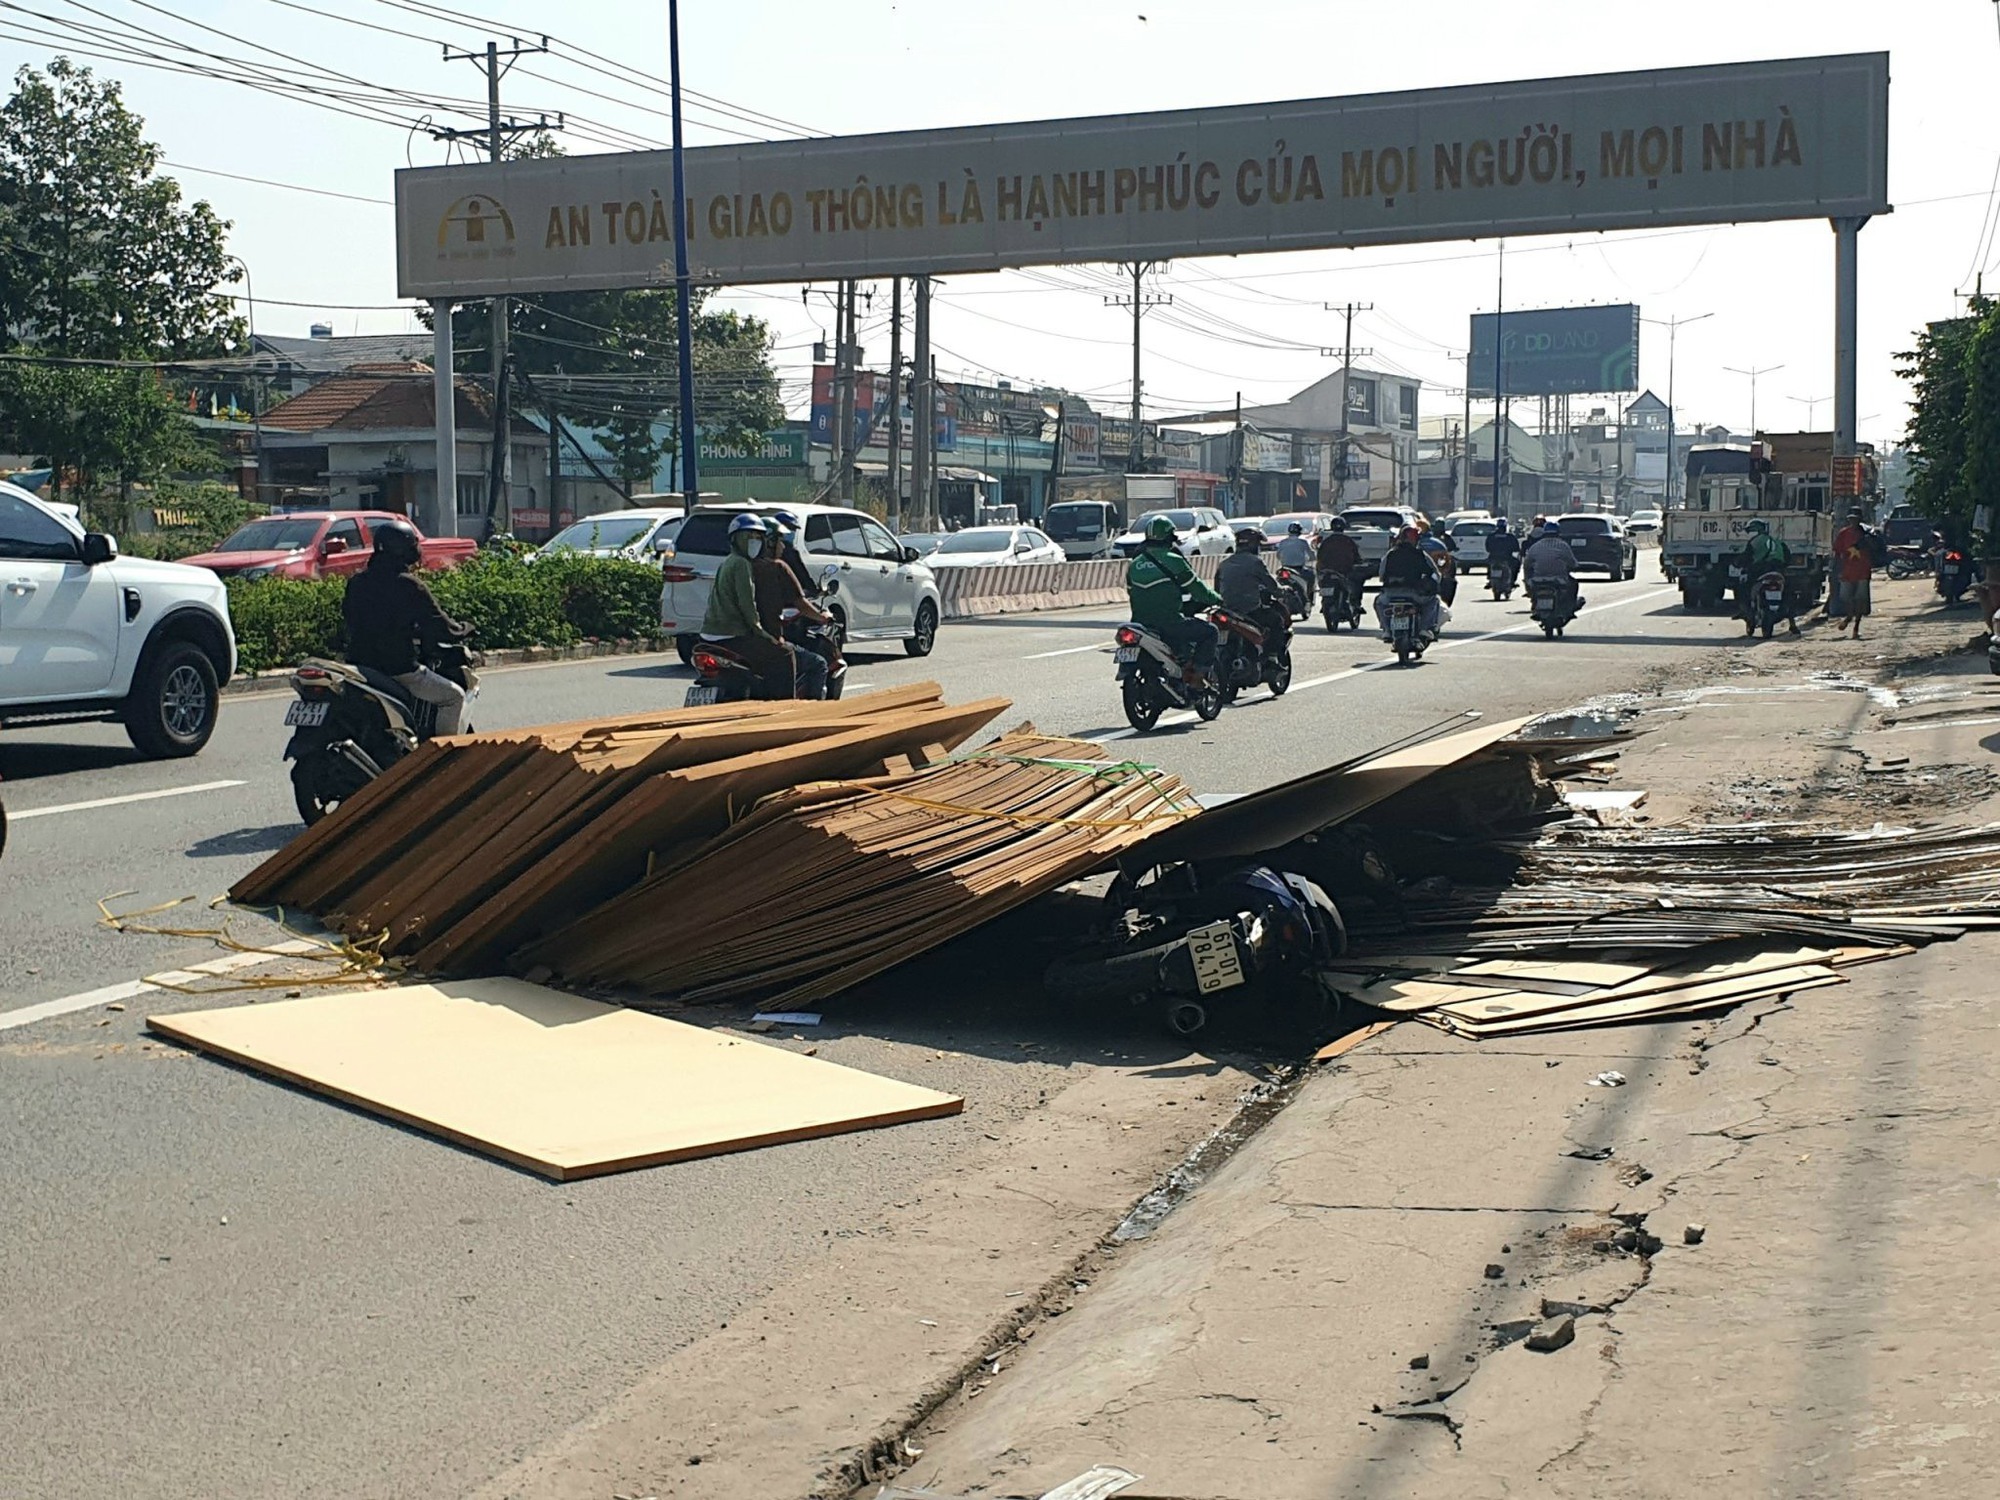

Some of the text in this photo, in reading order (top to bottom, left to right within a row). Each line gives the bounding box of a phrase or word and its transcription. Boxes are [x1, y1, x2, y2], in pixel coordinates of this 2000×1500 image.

[545, 205, 590, 248] AN
[709, 191, 793, 240] GIAO
[806, 175, 923, 233] THÔNG
[939, 167, 985, 225] LÀ
[997, 170, 1106, 231] HẠNH
[1114, 151, 1221, 214] PHÚC
[1236, 139, 1324, 207] CỦA
[1342, 146, 1417, 208] MỌI
[1435, 122, 1586, 190] NGƯỜI,
[1600, 125, 1683, 190] MỌI
[1703, 104, 1802, 171] NHÀ
[1191, 931, 1221, 989] 784.19
